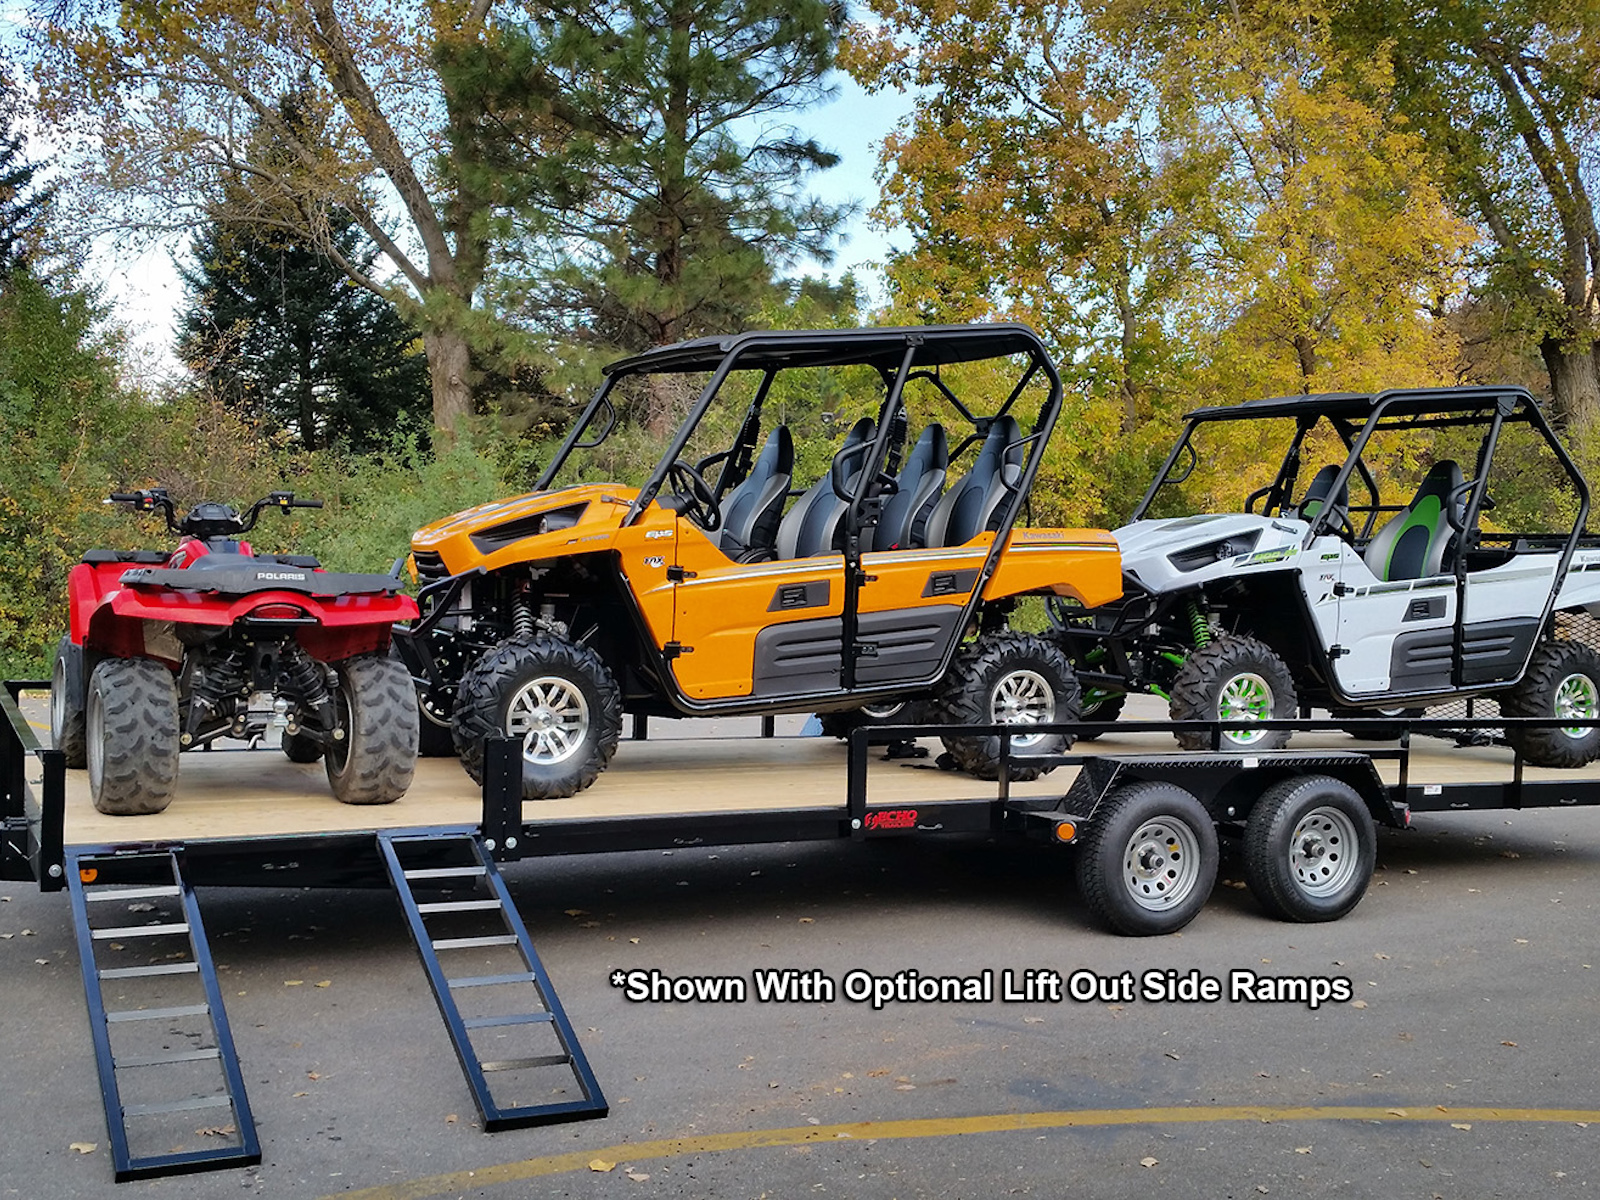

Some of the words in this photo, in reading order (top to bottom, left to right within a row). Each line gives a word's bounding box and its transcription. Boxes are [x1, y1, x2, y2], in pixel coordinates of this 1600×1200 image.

[1022, 531, 1064, 539] Kawasaki
[257, 572, 306, 580] POLARIS
[878, 809, 918, 821] ECHO
